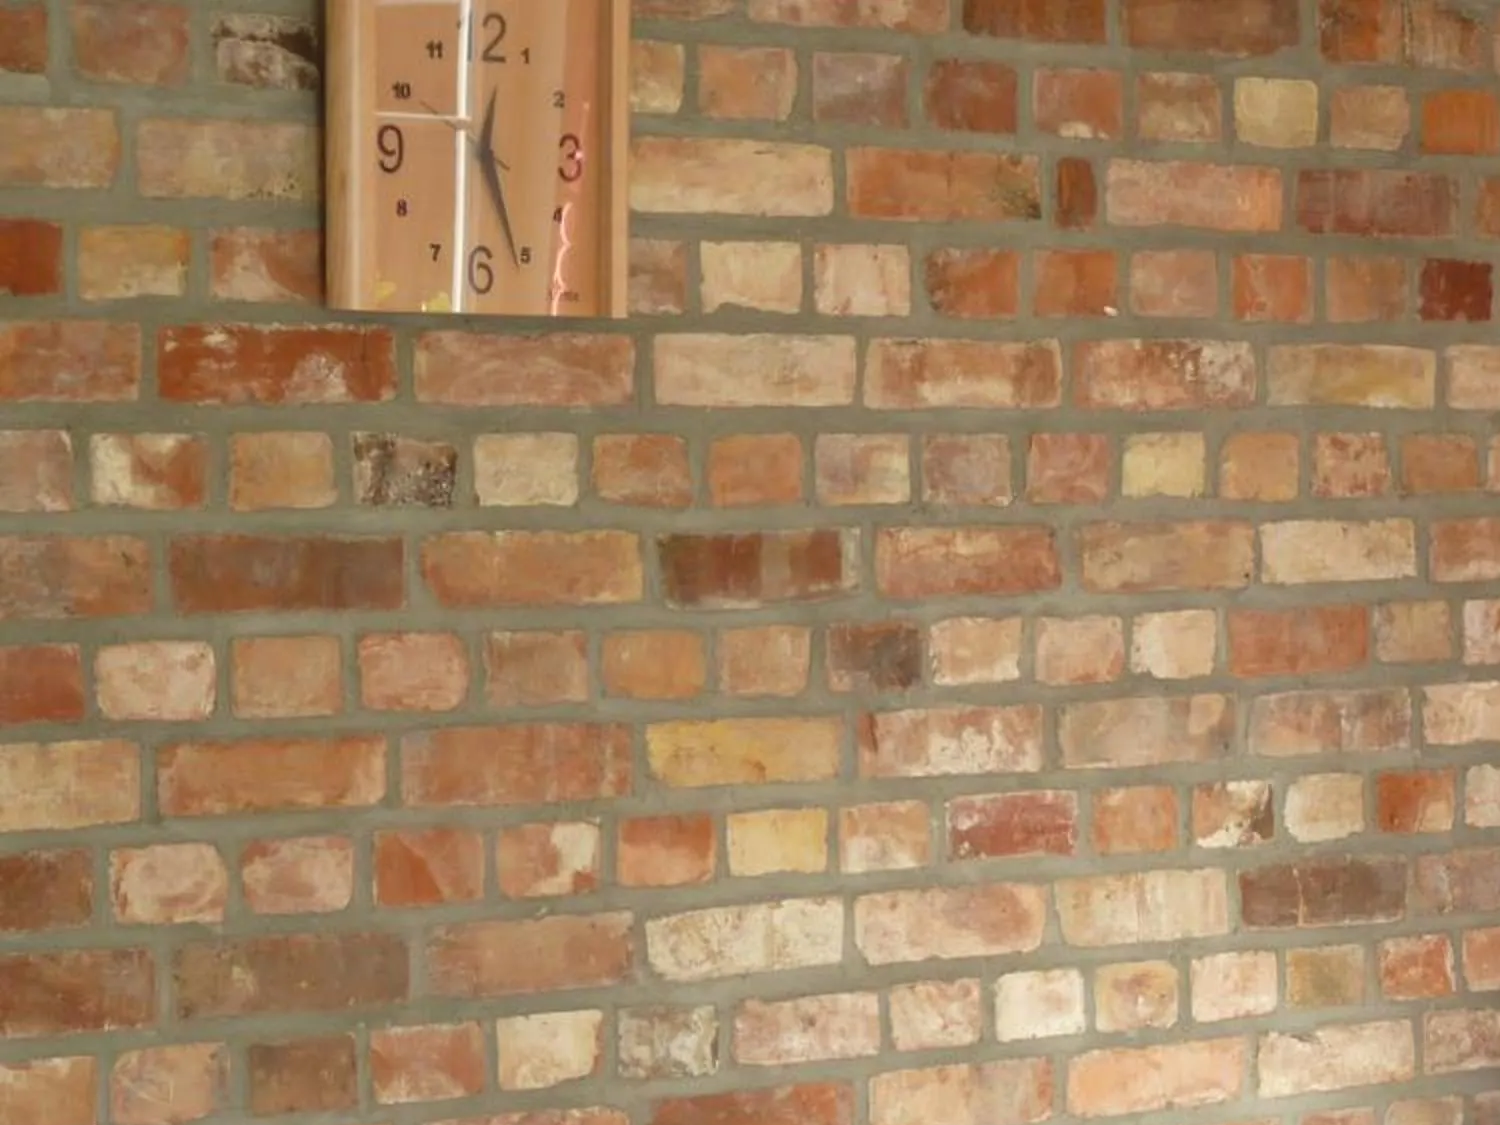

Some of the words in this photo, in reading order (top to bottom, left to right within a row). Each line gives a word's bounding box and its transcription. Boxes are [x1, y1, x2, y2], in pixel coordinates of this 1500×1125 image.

[425, 41, 443, 59] 11
[520, 48, 530, 64] 1
[392, 82, 410, 99] 10
[553, 91, 565, 108] 2
[377, 124, 404, 173] 9
[558, 134, 582, 182] 3
[396, 200, 407, 216] 8
[430, 245, 441, 261] 7
[520, 248, 530, 264] 5
[468, 246, 494, 294] 6
